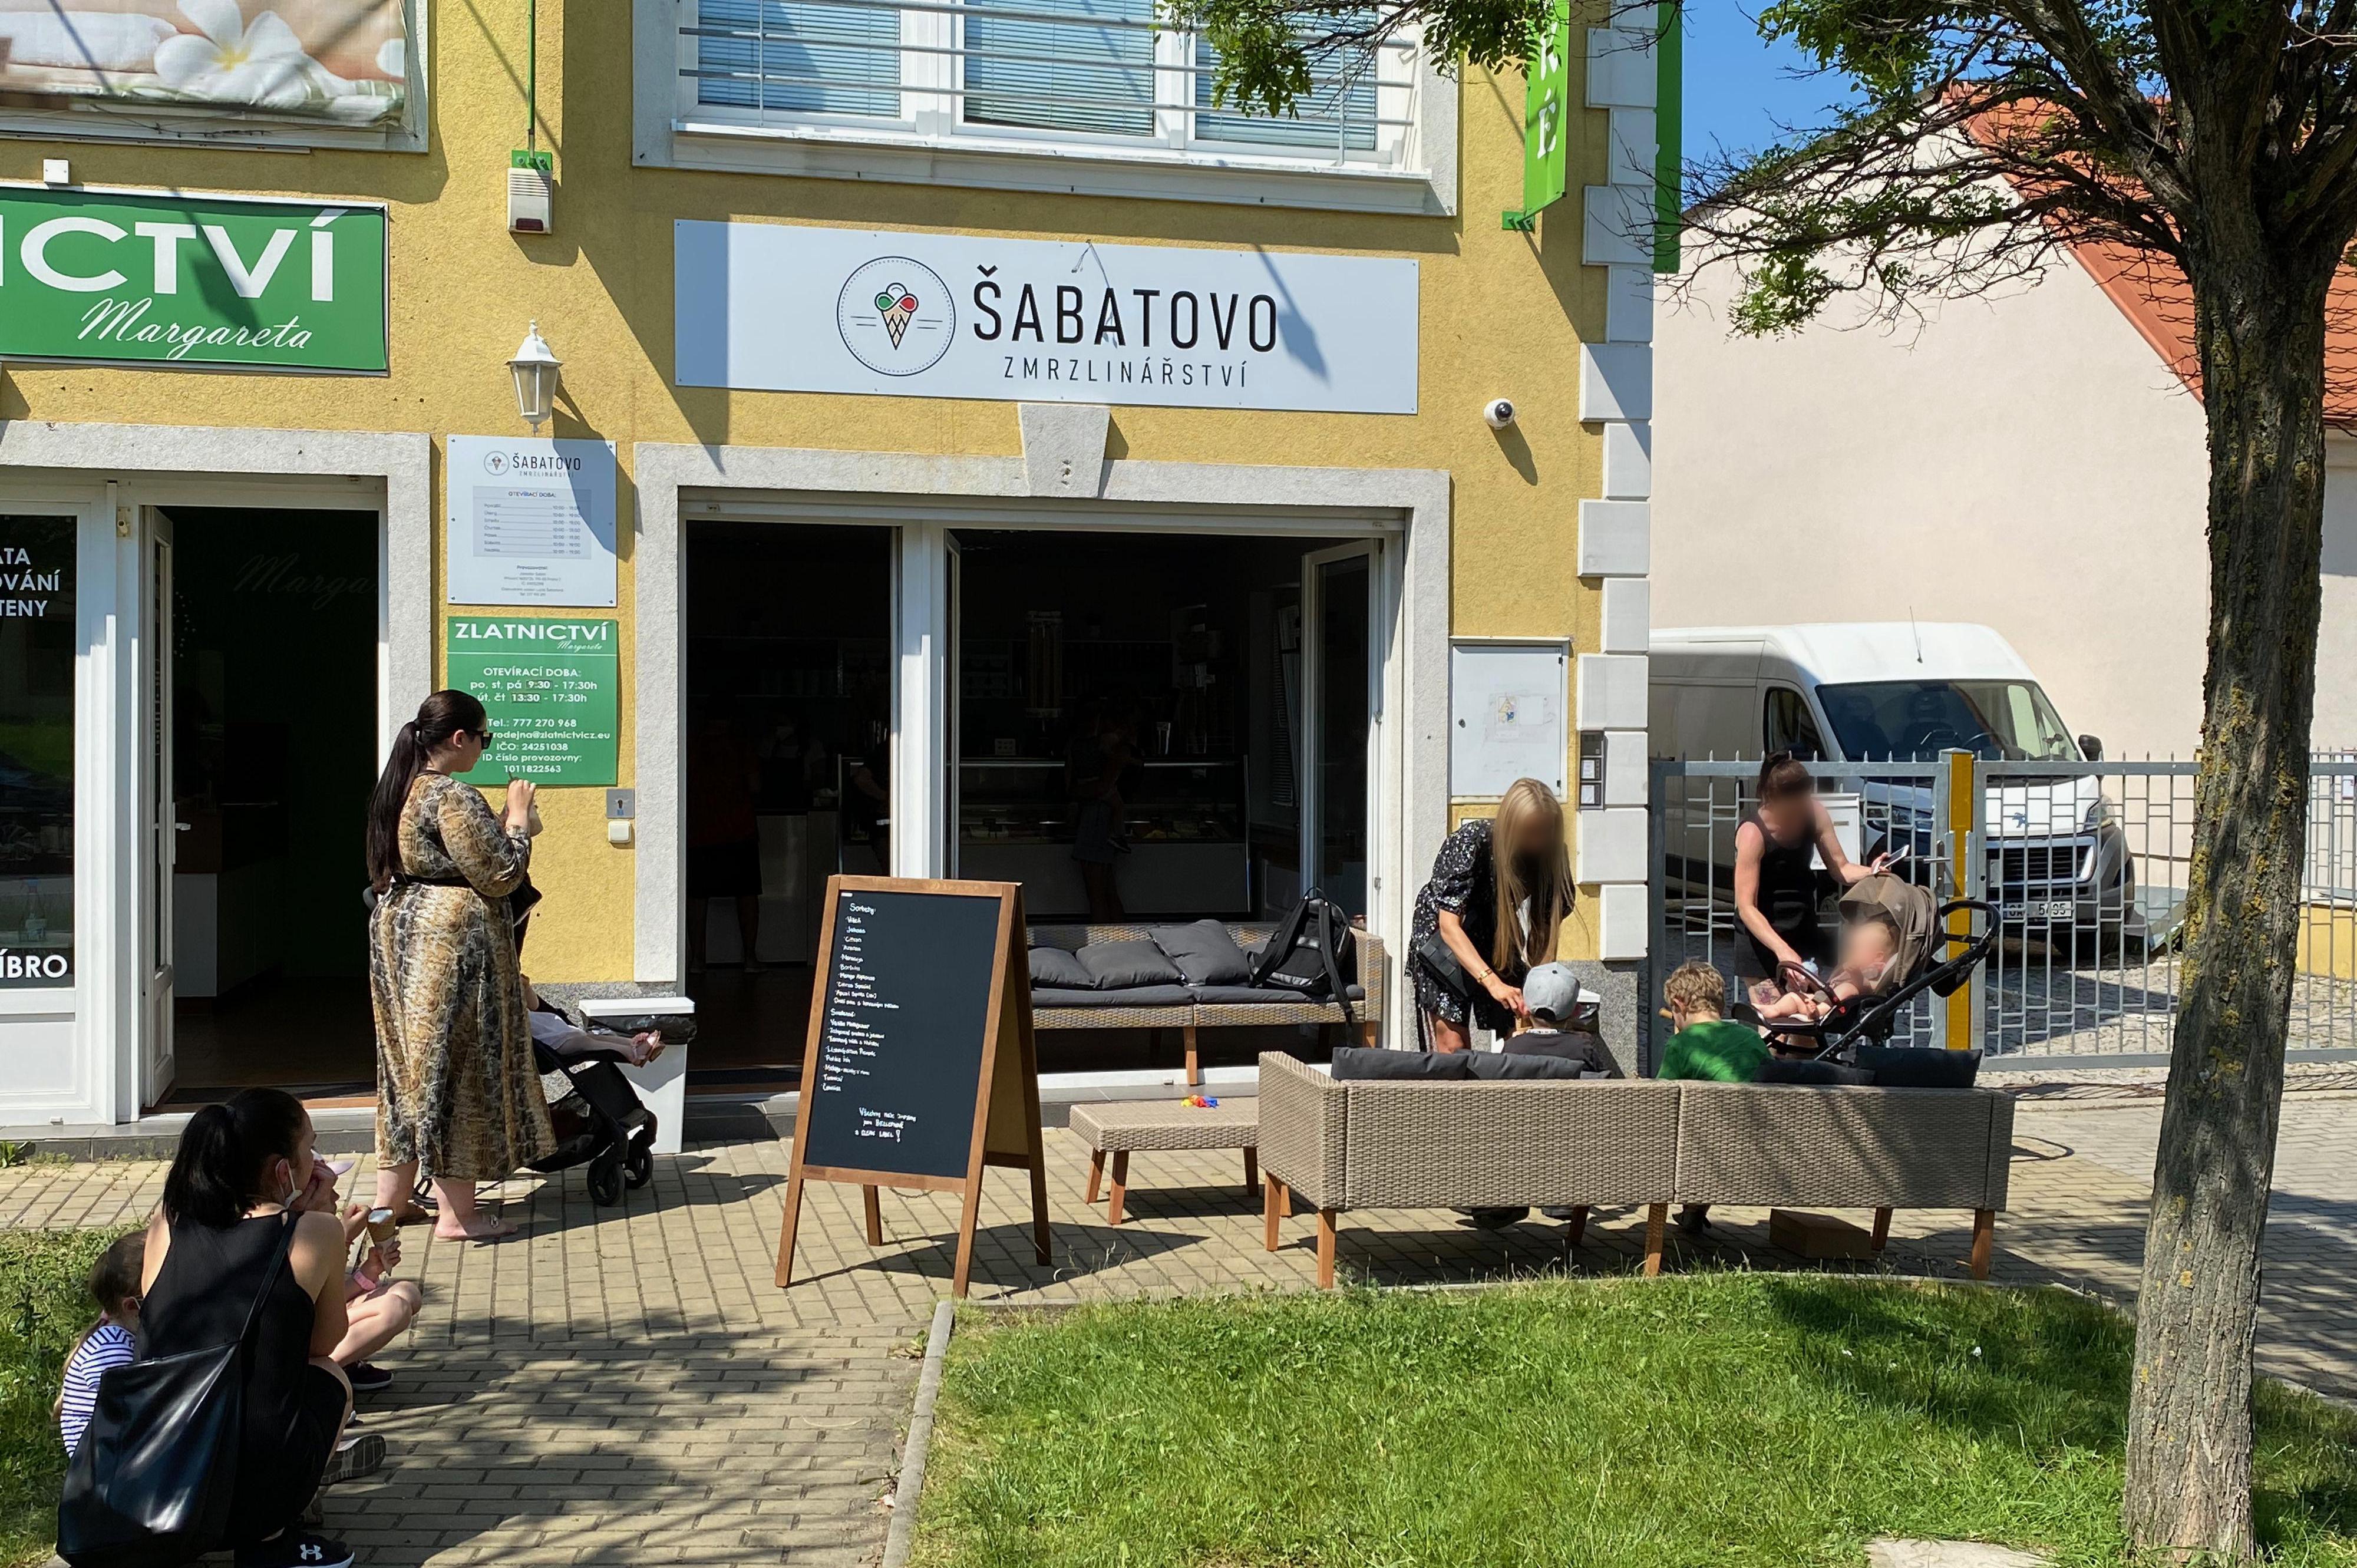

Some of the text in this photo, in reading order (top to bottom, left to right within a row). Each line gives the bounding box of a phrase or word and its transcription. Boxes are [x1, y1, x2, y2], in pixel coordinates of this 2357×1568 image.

[0, 209, 349, 301] CTVÍ
[974, 265, 1276, 352] ŠABATOVO
[77, 298, 313, 360] Margareta
[1004, 356, 1247, 388] ZMRZLINÁŘSTVÍ
[513, 453, 581, 470] ŠABATOVO
[0, 548, 31, 565] TA
[0, 569, 61, 591] VÁNÍ
[234, 552, 378, 610] Marga
[455, 621, 609, 641] ZLATNICTVÍ
[556, 640, 603, 652] Margareta
[483, 666, 582, 677] OTEVÍRACÍ DOBA:
[470, 681, 488, 690] po,
[507, 680, 522, 691] pá
[562, 681, 597, 689] 17:30h
[494, 693, 506, 701] čt
[553, 694, 587, 702] 17:30h
[513, 719, 532, 727] 777
[493, 731, 610, 740] rodejna@zlatnictvicz.eu
[496, 753, 519, 761] číslo
[521, 755, 582, 763] provozovny:
[0, 949, 68, 978] ÍBRO
